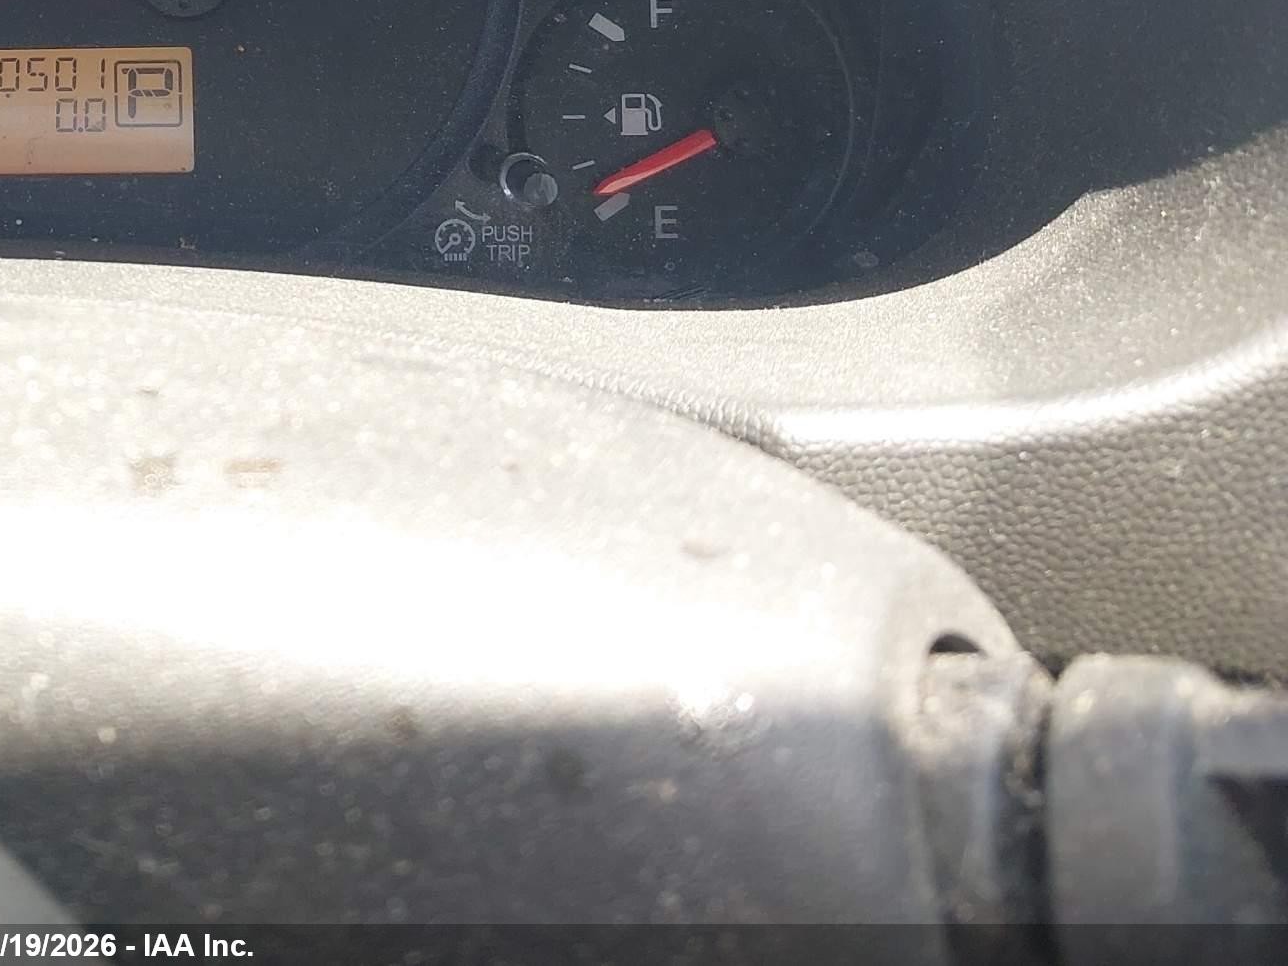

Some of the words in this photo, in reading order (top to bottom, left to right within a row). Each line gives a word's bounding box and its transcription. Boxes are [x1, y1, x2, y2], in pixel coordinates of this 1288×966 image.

[121, 66, 174, 119] P
[55, 97, 107, 133] 0.0
[481, 224, 533, 244] PUSH
[654, 205, 679, 240] E
[486, 243, 531, 263] TRIP
